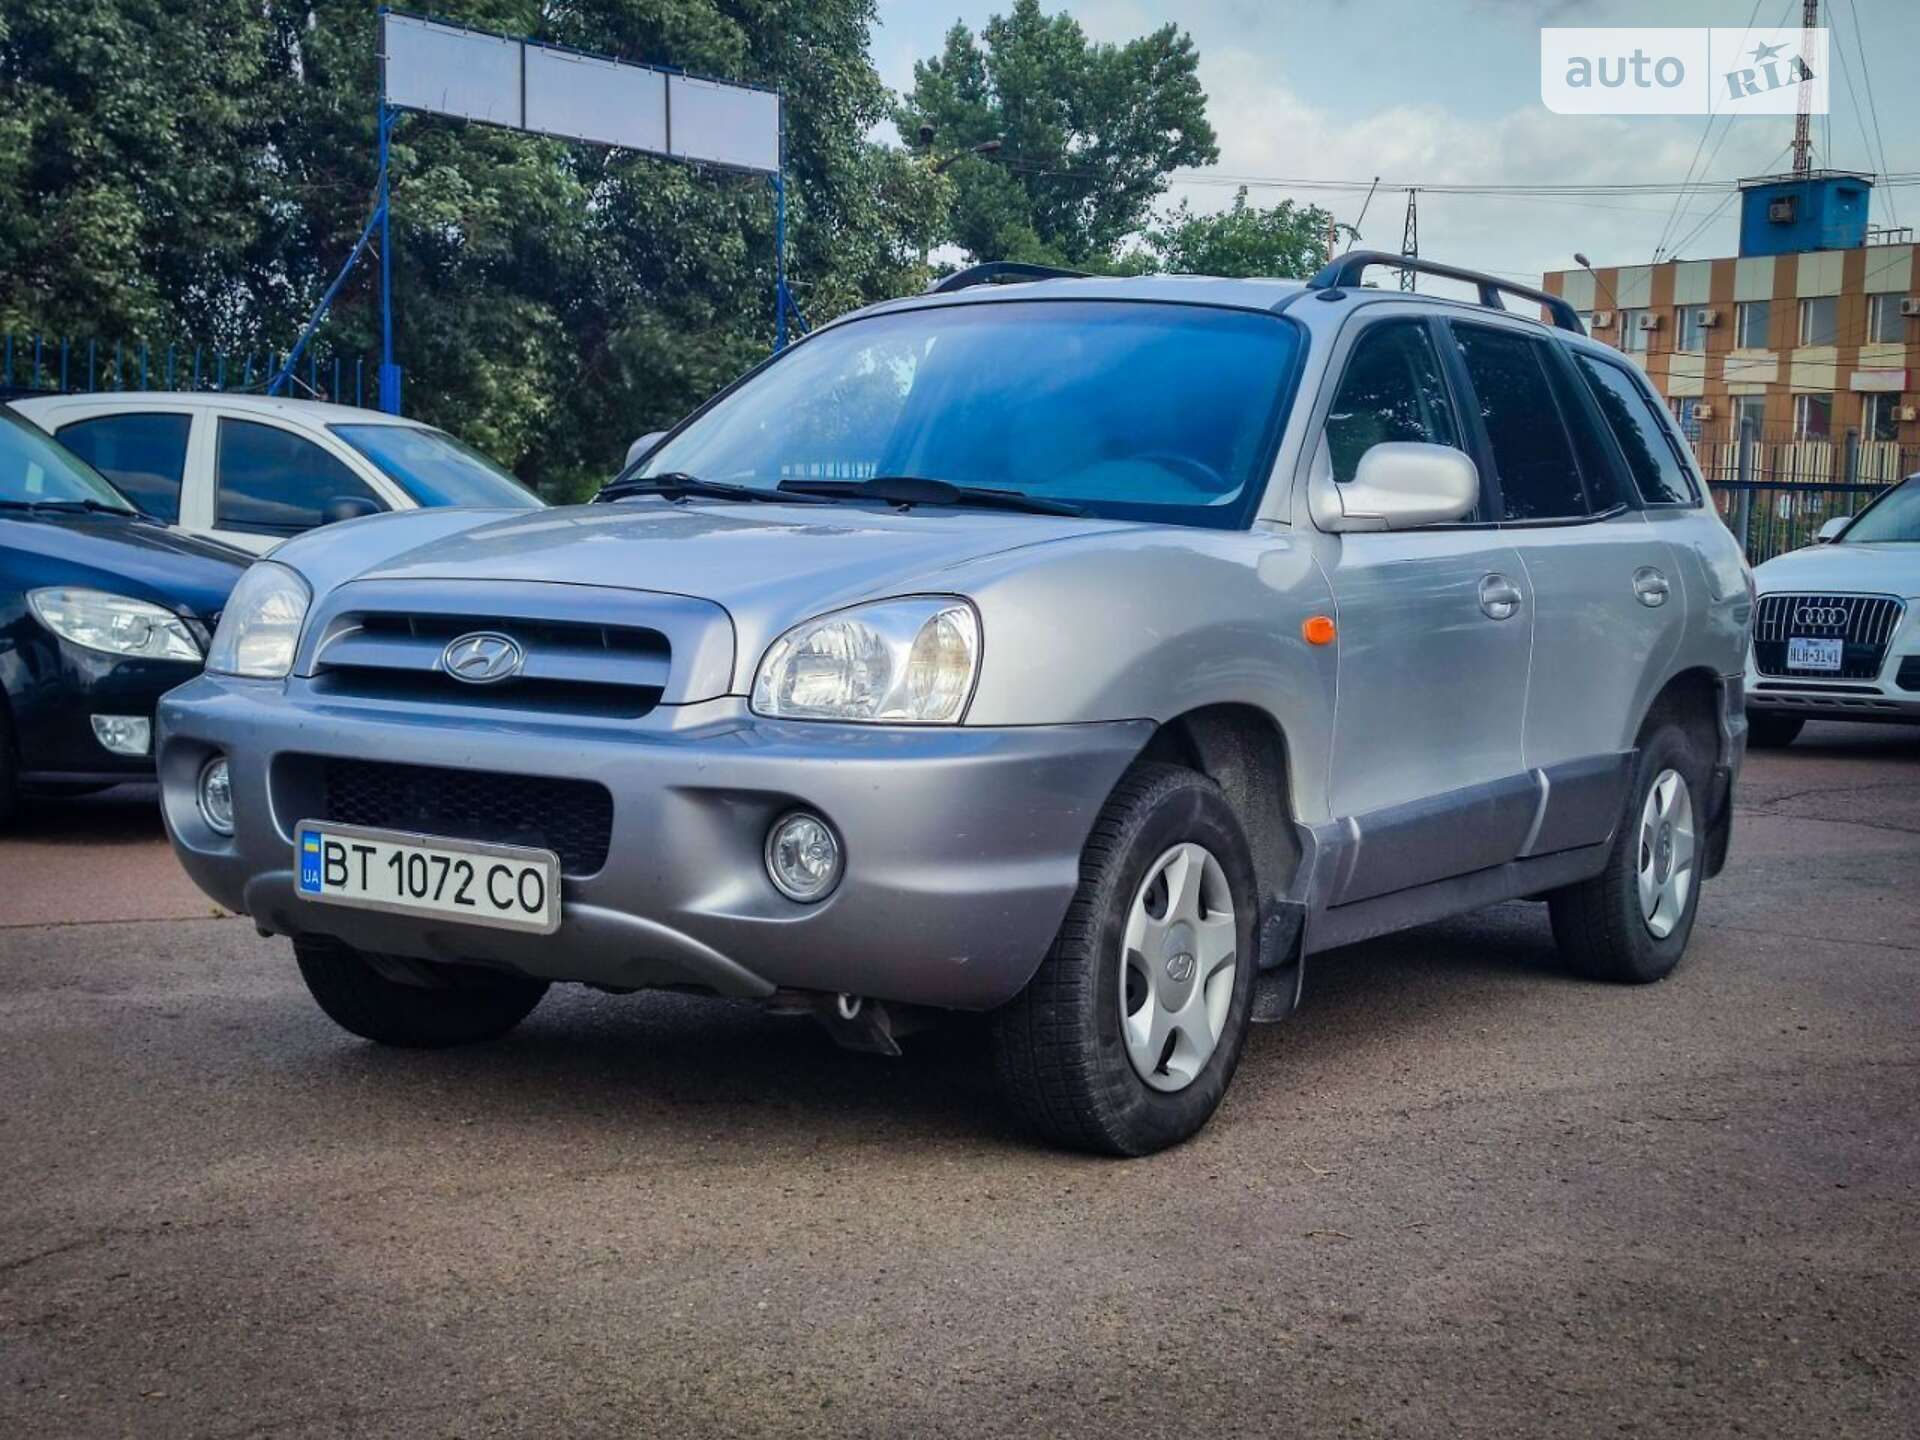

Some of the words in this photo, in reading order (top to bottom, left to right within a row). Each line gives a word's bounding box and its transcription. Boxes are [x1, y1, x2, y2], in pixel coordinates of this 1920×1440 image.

[303, 869, 319, 885] UA
[324, 841, 376, 890] BT
[388, 850, 475, 905] 1072
[487, 863, 545, 914] CO
